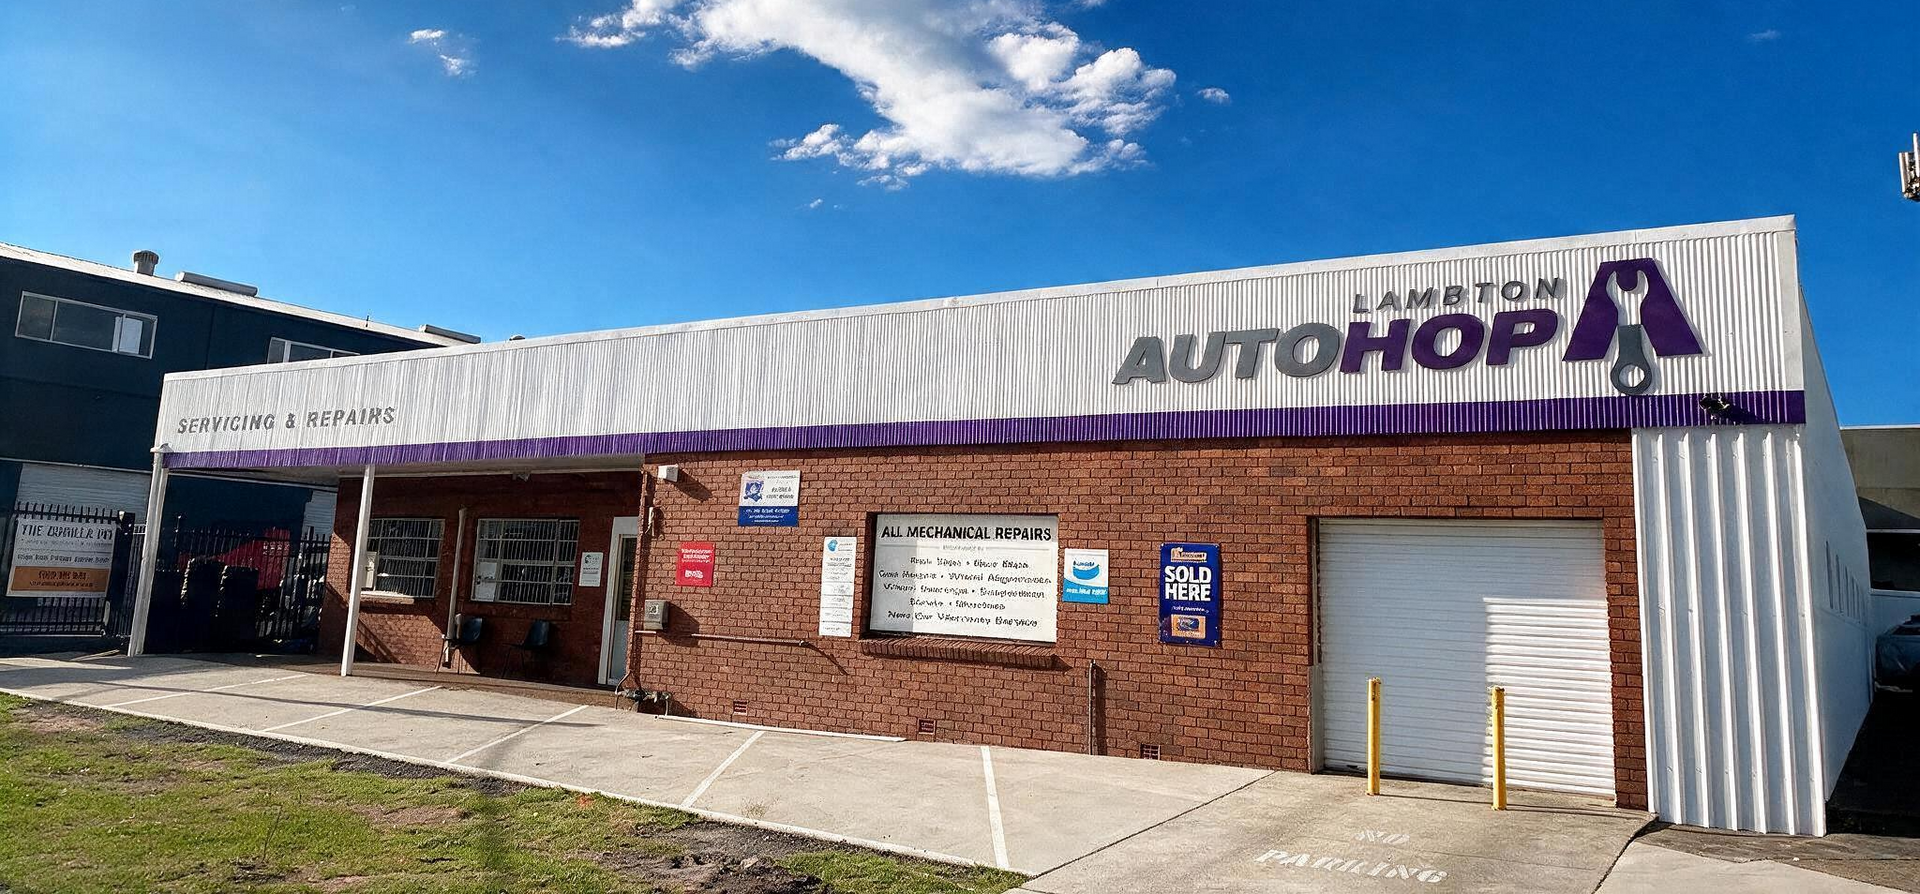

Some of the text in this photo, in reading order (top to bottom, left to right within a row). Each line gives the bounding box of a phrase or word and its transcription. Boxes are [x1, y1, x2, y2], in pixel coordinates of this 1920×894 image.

[1353, 276, 1564, 314] LAMBTON
[177, 413, 275, 434] SERVICING
[285, 412, 296, 429] &
[881, 525, 1052, 541] ALL MECHANICAL REPAIRS
[1164, 565, 1212, 583] SOLD
[1165, 583, 1211, 602] HERE
[1254, 849, 1448, 883] PARKING
